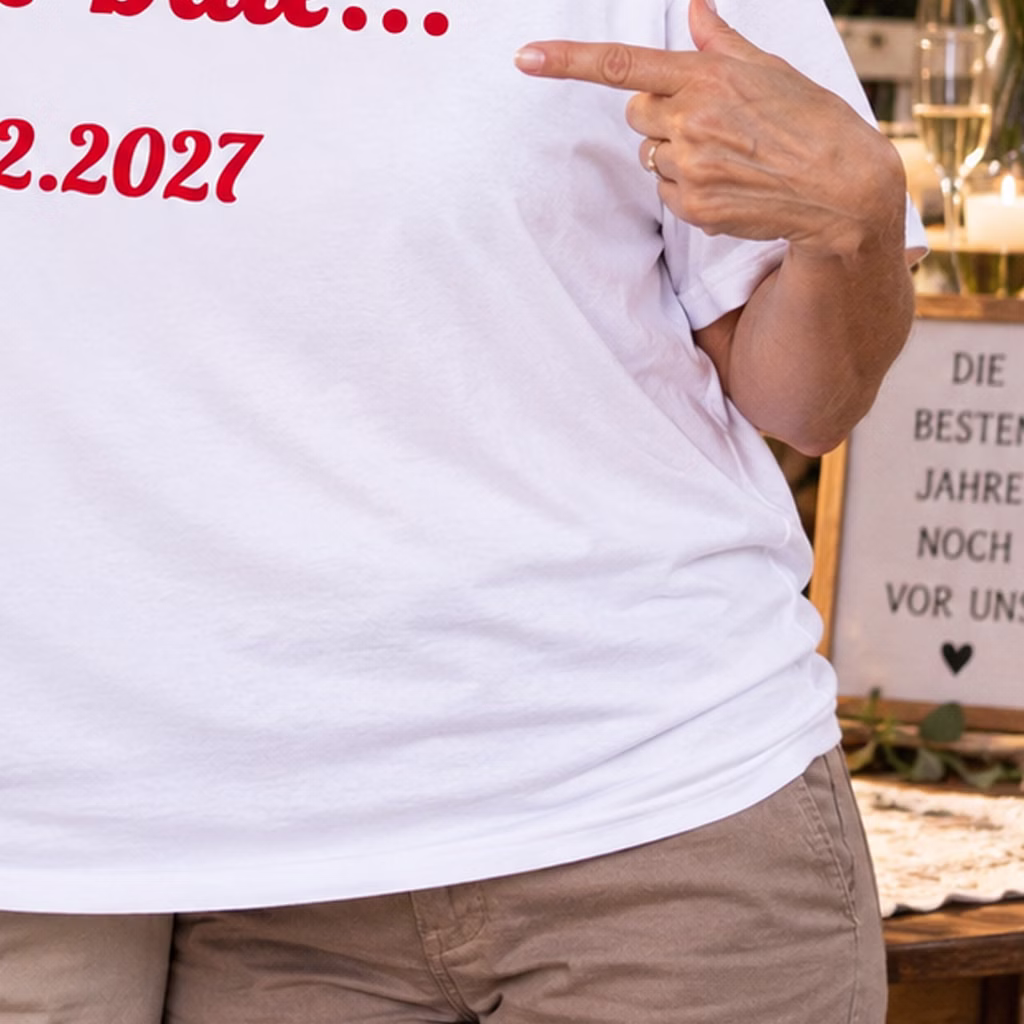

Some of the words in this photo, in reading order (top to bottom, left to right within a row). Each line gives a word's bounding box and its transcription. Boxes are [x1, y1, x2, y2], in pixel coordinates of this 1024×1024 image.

[951, 351, 1006, 387] DIE
[915, 468, 1023, 505] JAHRE
[917, 526, 1013, 564] NOCH
[885, 582, 953, 618] VOR
